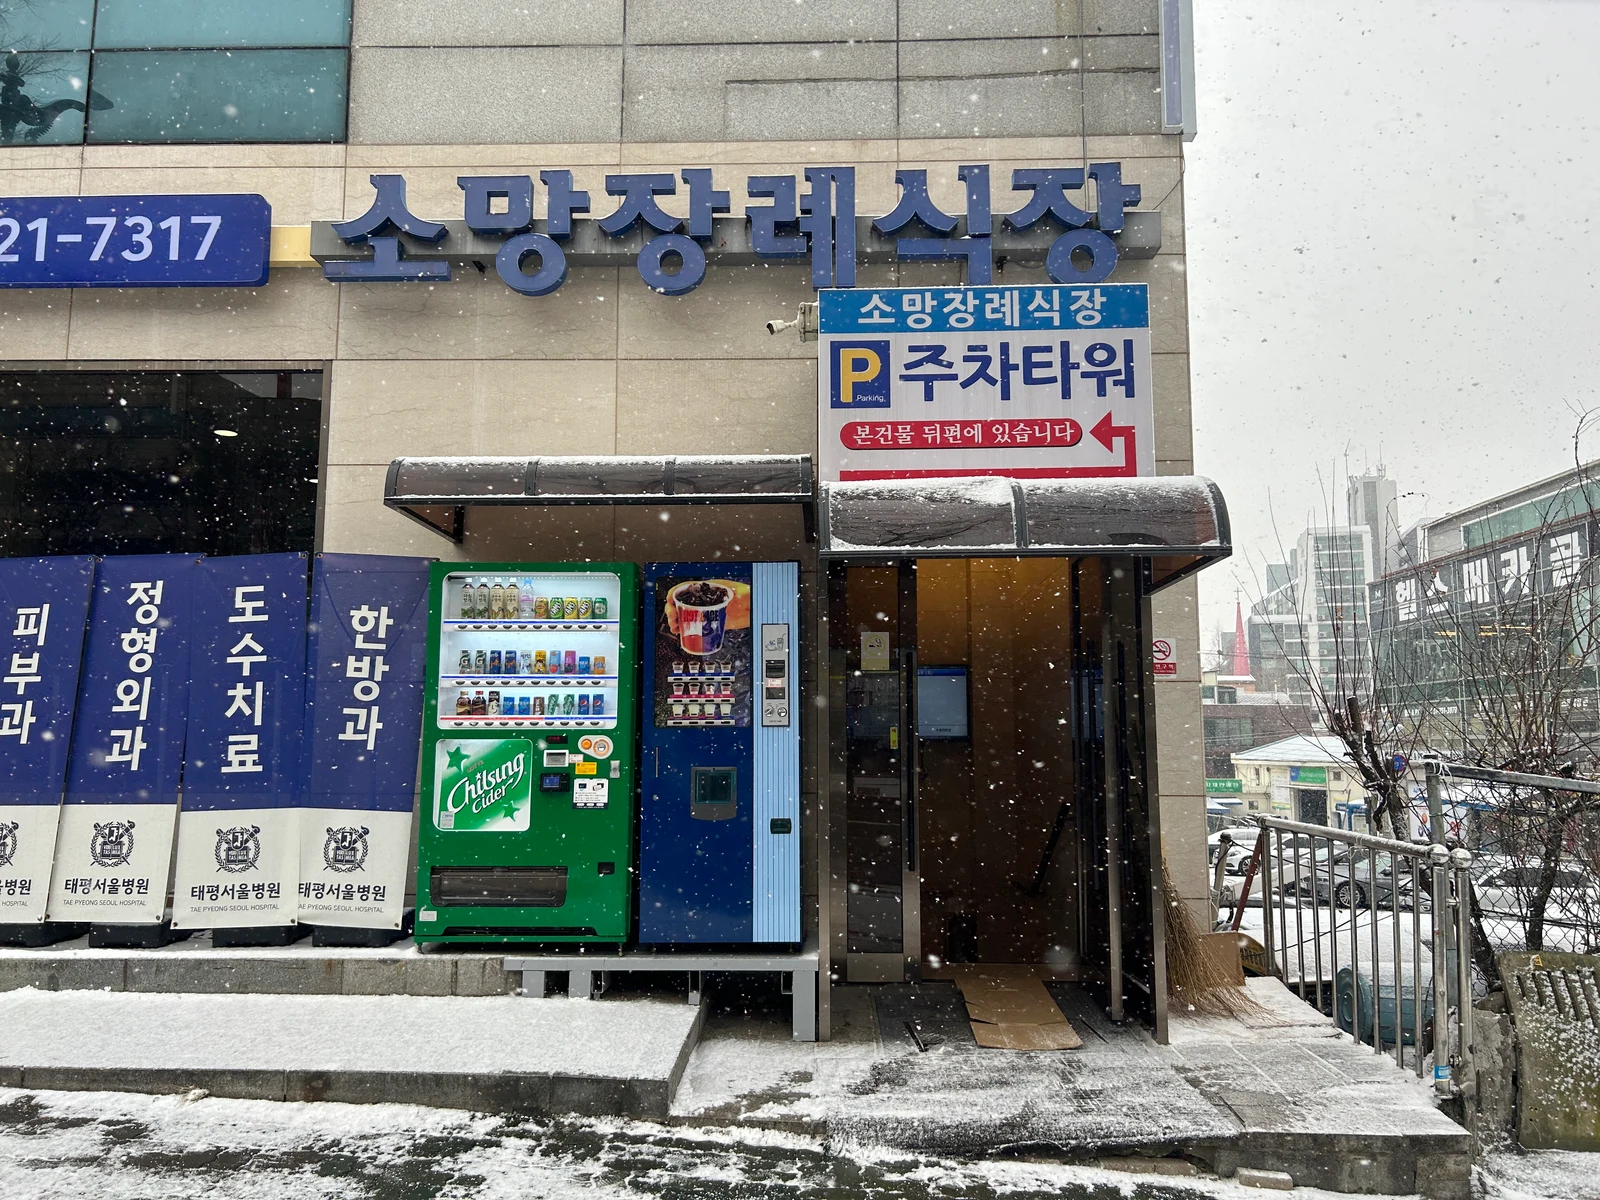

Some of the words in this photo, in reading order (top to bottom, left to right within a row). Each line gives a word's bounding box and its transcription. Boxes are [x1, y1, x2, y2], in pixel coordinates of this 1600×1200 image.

[0, 214, 222, 263] 21-7317
[324, 162, 1141, 296] 소망장례식장
[857, 289, 1107, 329] 소망장례식장
[840, 347, 881, 403] P
[899, 338, 1136, 402] 주차타워
[856, 394, 885, 403] Parking
[852, 424, 915, 445] 본건물
[921, 423, 983, 444] 뒤편에
[991, 421, 1075, 443] 있습니다
[0, 603, 51, 745] 피부과
[104, 580, 165, 771] 정형외과
[220, 585, 269, 773] 도수치료
[337, 604, 395, 751] 한방과
[447, 752, 525, 814] Chilsung
[0, 878, 32, 896] 병원
[64, 878, 149, 896] 태평서울병원
[190, 882, 281, 901] 태평서울병원
[250, 903, 280, 911] HOSPITAL
[298, 882, 386, 902] 태평서울병원
